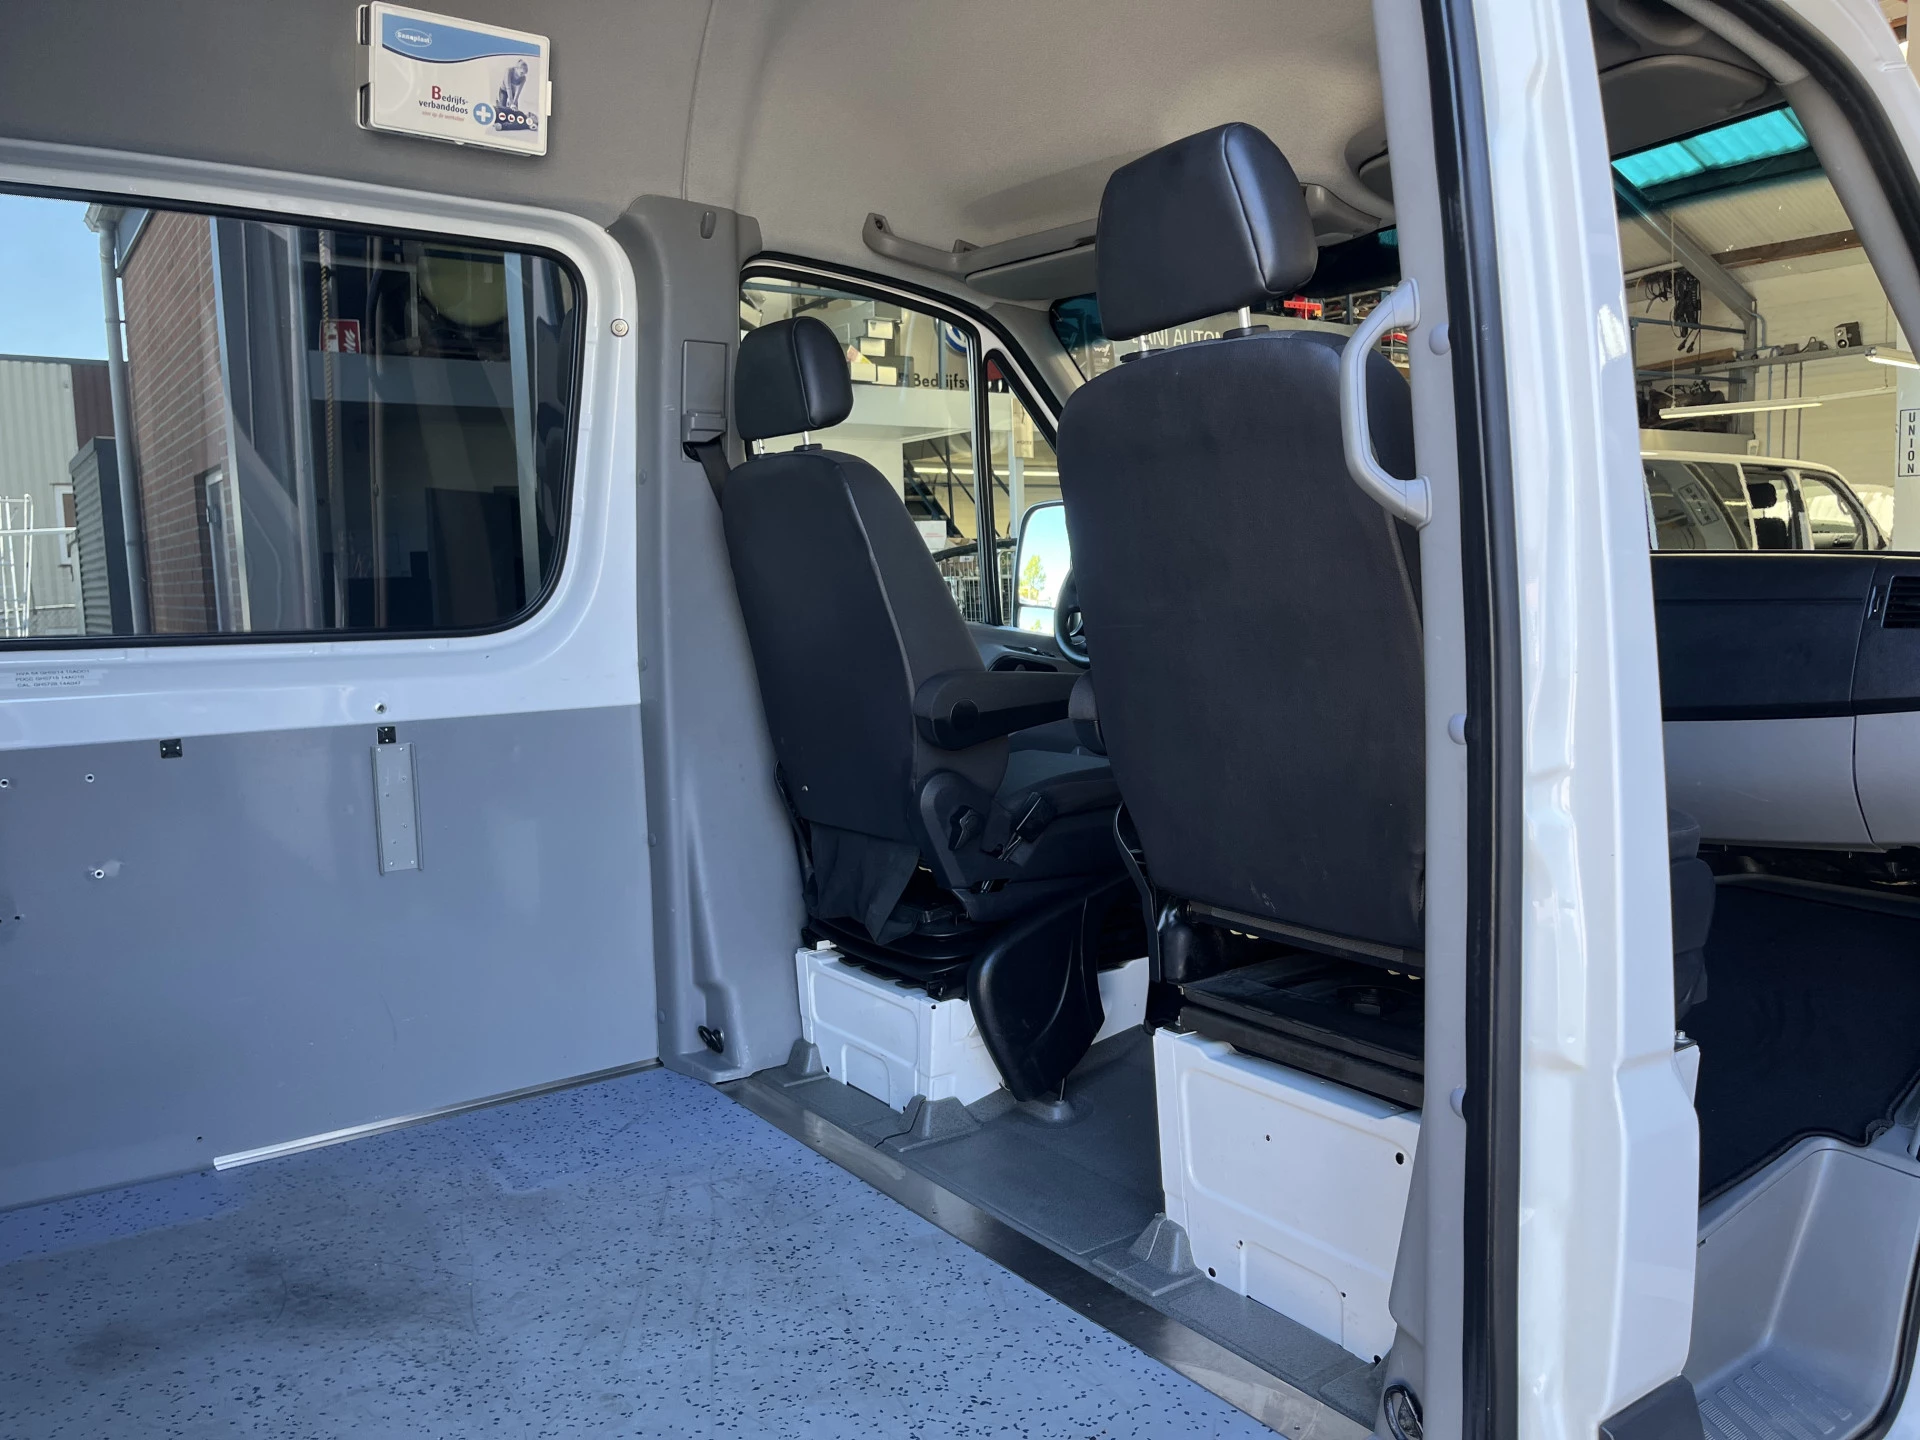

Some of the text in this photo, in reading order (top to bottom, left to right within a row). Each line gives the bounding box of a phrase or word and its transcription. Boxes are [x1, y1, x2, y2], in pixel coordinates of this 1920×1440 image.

[431, 85, 469, 105] Bedrijfs-
[418, 100, 469, 114] verbanddoos
[1907, 411, 1916, 474] UNION
